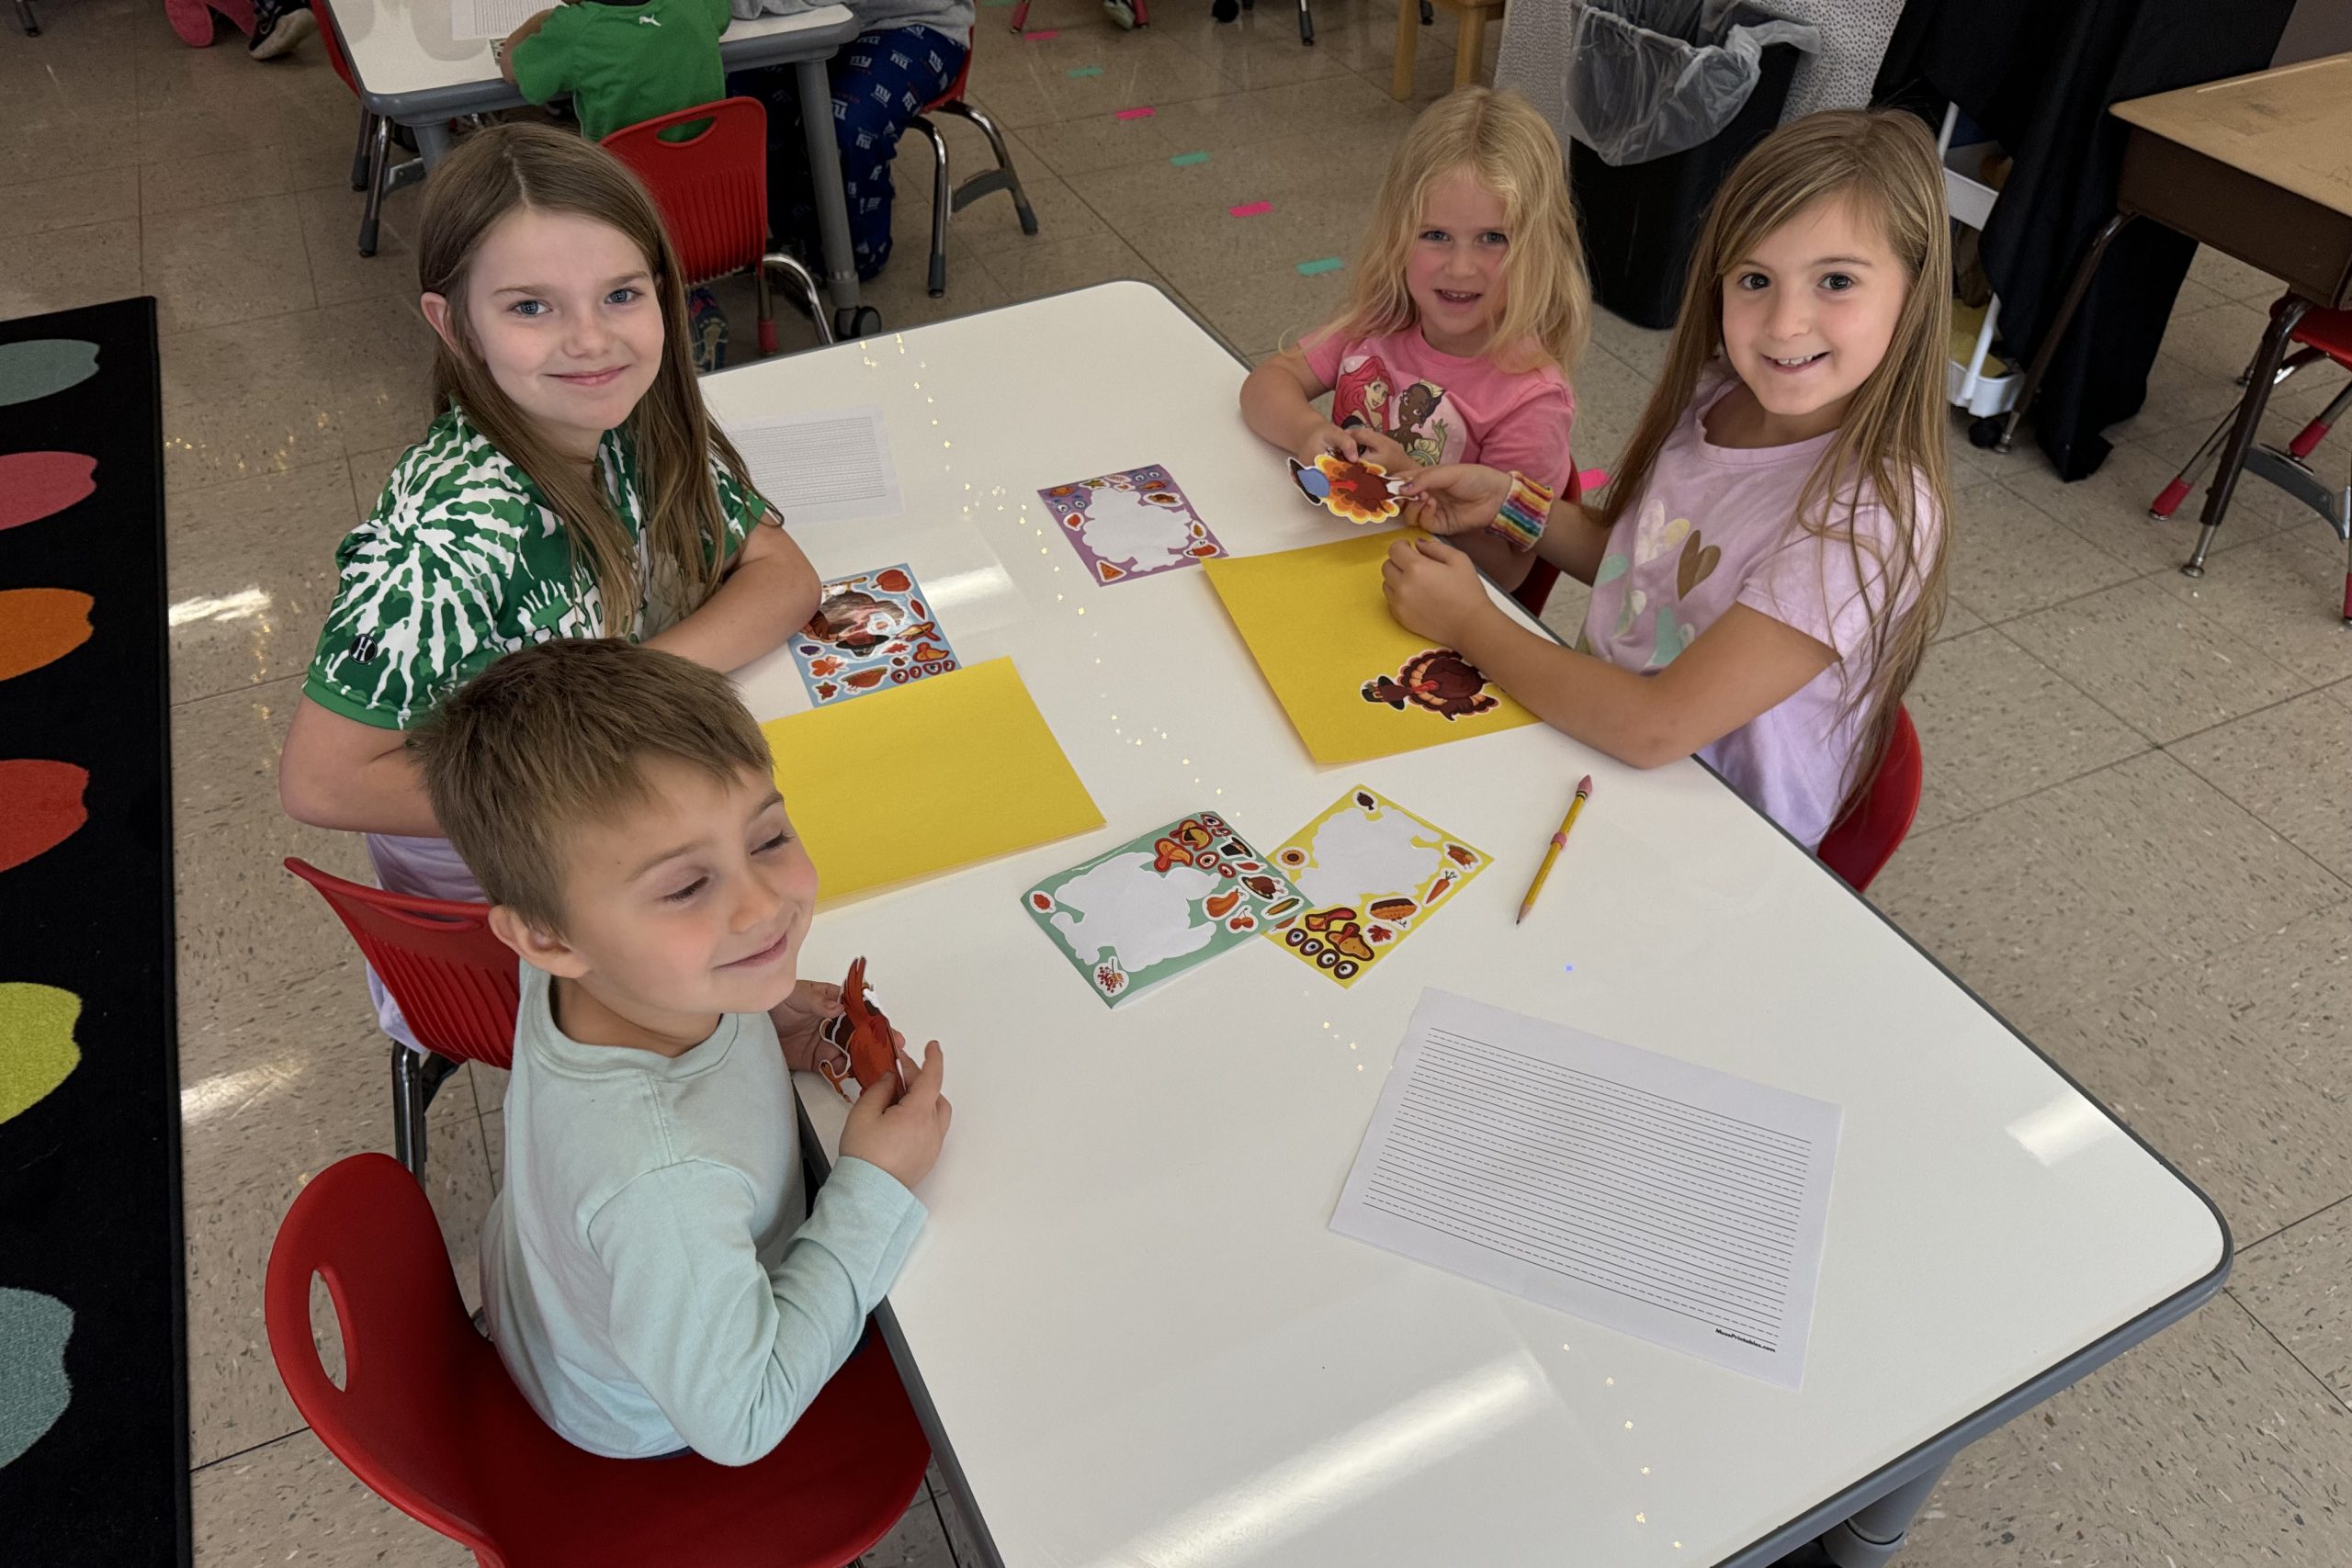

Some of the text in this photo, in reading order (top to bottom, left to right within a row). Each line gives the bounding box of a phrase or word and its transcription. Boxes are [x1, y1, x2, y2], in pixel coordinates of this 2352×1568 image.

[850, 55, 872, 68] ny
[353, 637, 372, 661] H
[1715, 1328, 1776, 1352] MusePrintables.com
